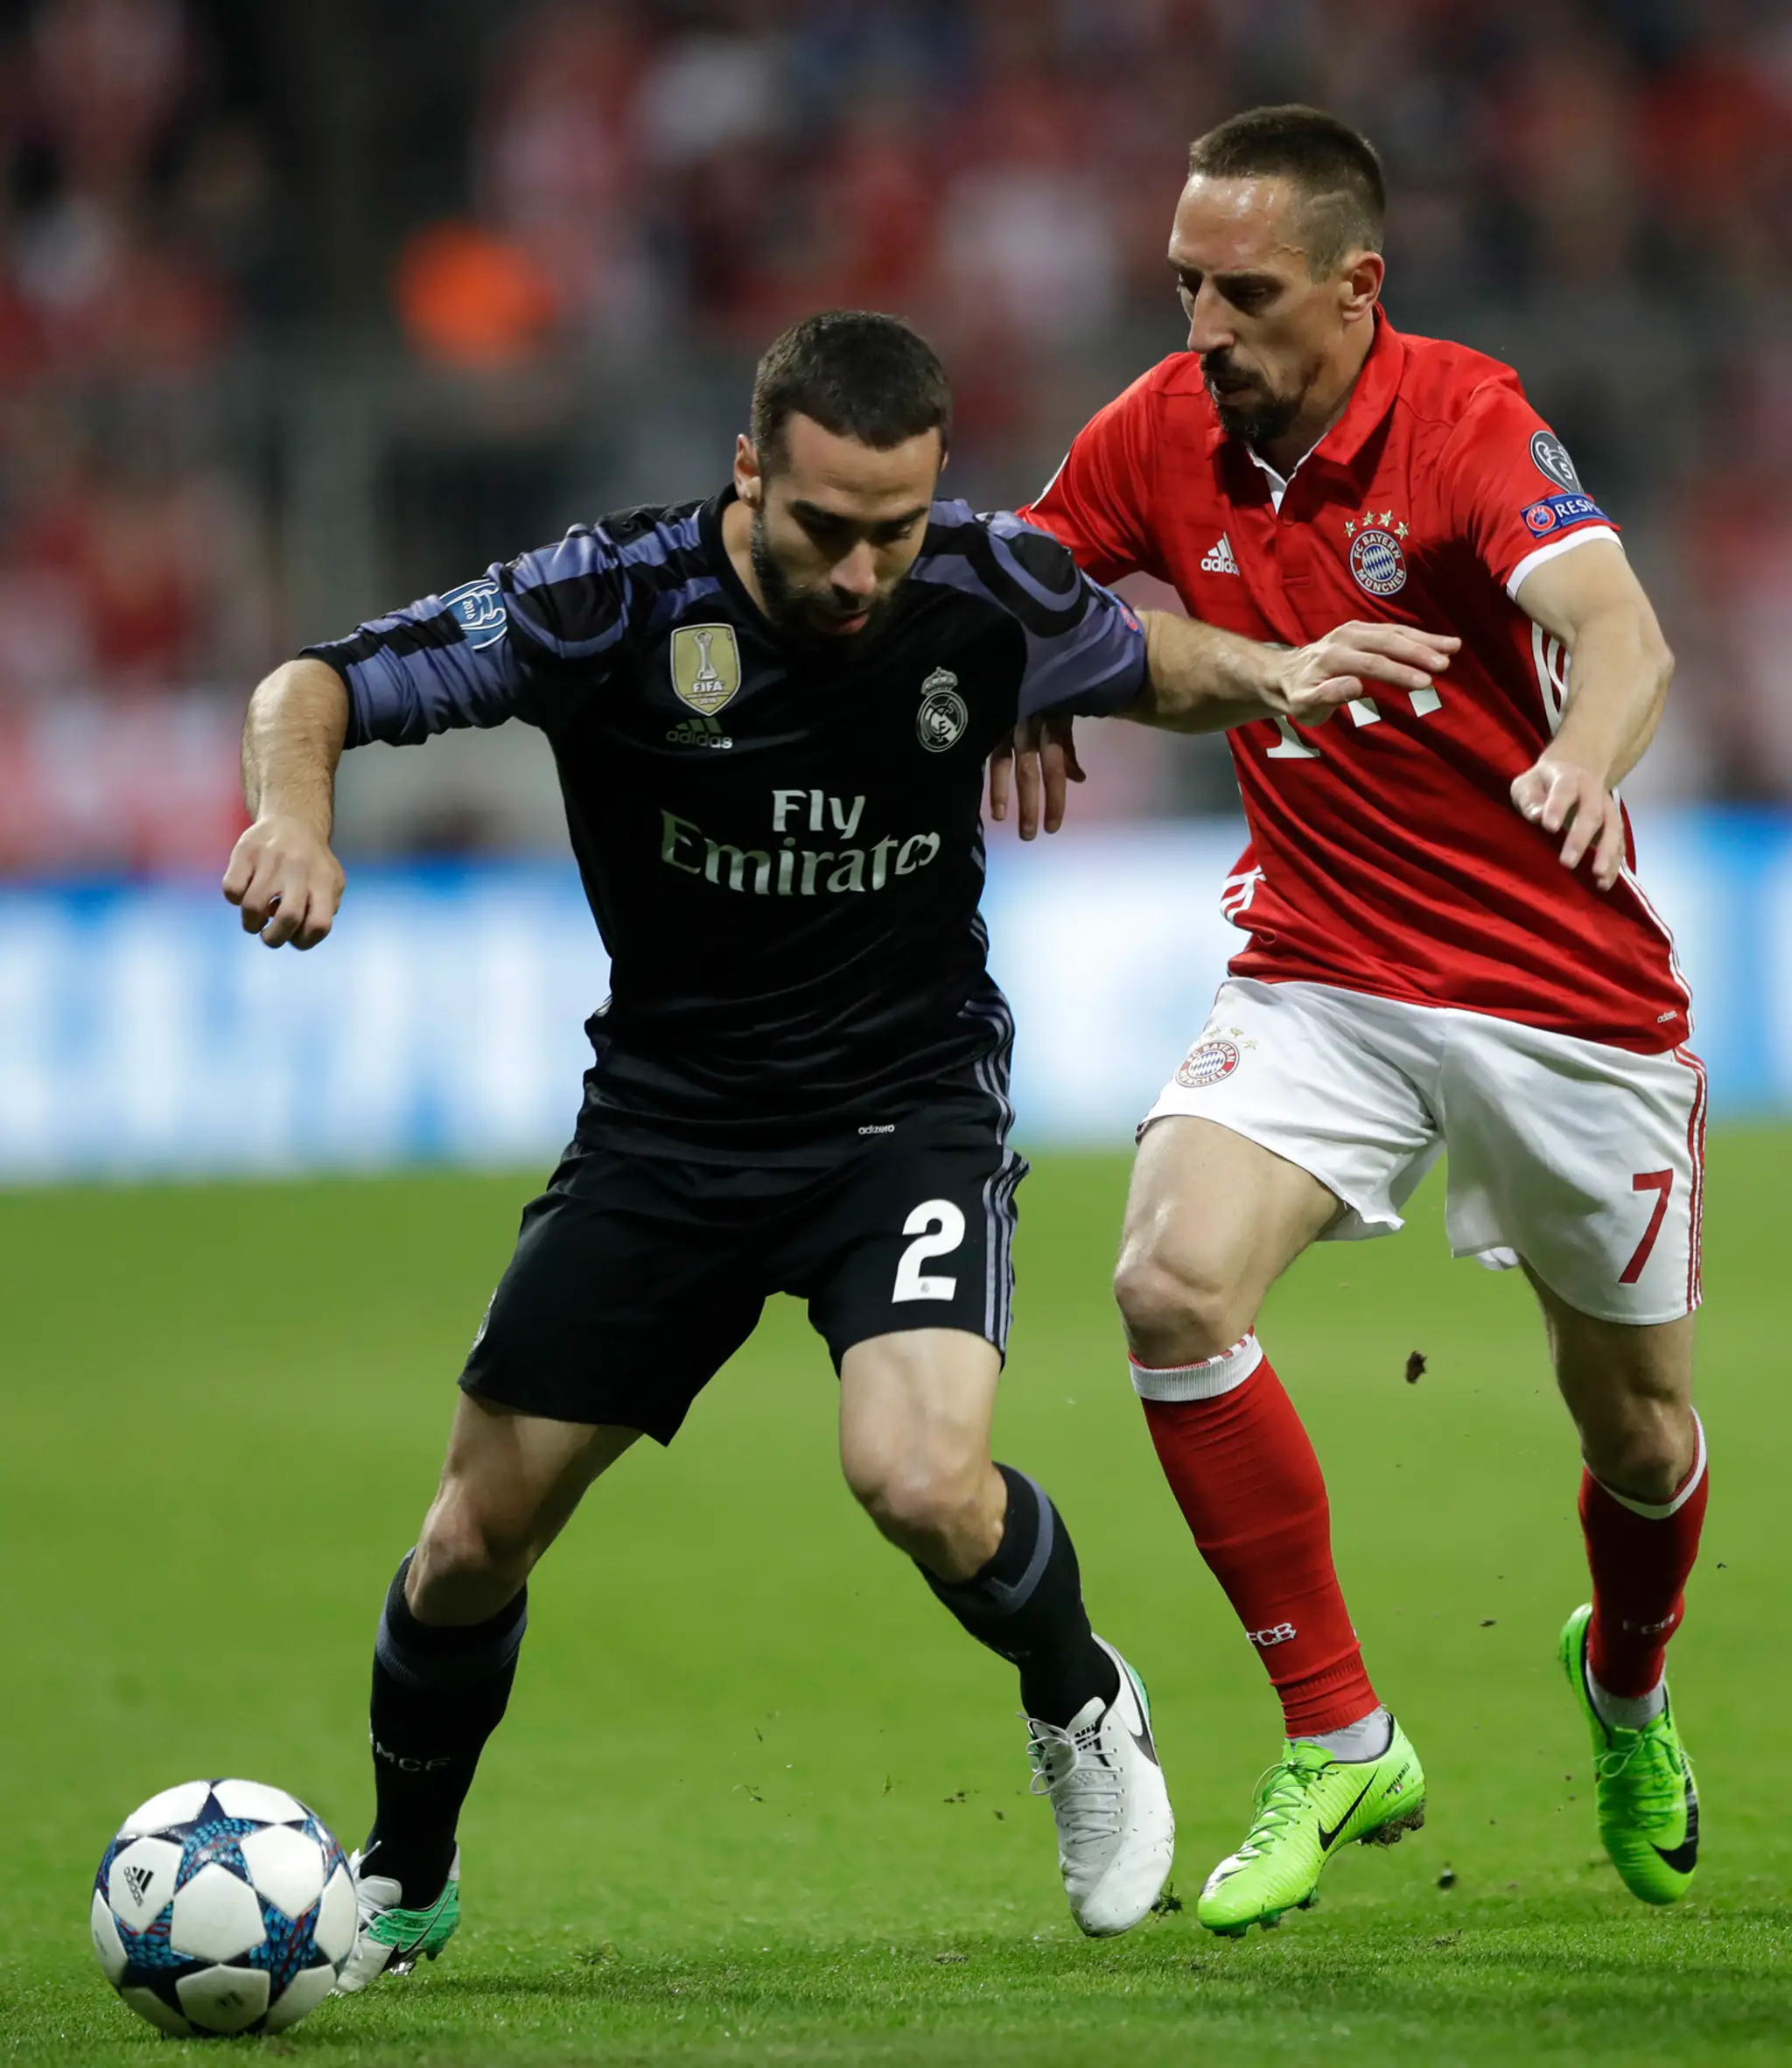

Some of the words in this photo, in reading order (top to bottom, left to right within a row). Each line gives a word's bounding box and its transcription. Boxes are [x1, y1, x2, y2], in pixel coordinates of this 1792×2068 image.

[1559, 461, 1572, 480] 5
[1554, 499, 1604, 518] RESP
[1354, 543, 1364, 559] FC
[1362, 534, 1401, 559] BAYERN
[1200, 556, 1241, 577] adida
[461, 599, 477, 620] 2016
[692, 681, 724, 694] FIFA
[665, 730, 733, 750] adidas
[772, 789, 866, 840] Fly
[1202, 1042, 1236, 1062] BAYERN
[858, 1124, 895, 1136] adizero
[1618, 1168, 1673, 1284] 7
[892, 1198, 966, 1304] 2
[1246, 1622, 1297, 1646] FCB
[368, 1732, 452, 1772] MCF
[123, 1866, 144, 1908] adidas
